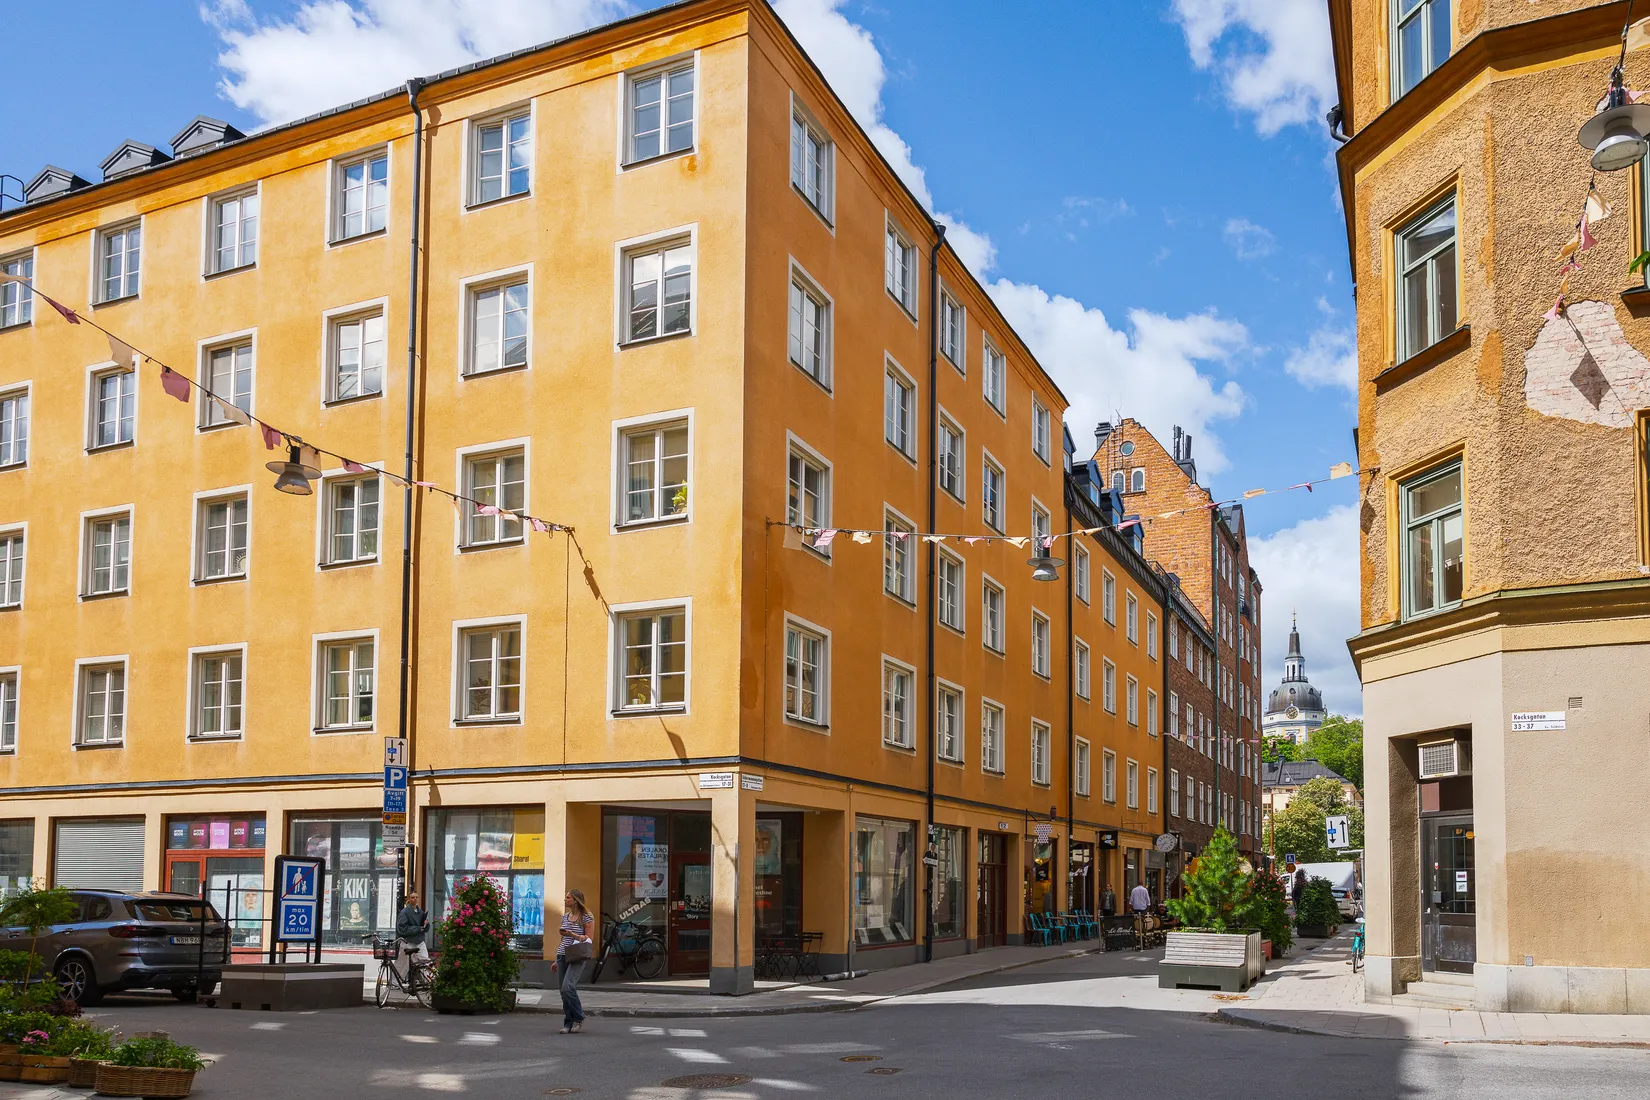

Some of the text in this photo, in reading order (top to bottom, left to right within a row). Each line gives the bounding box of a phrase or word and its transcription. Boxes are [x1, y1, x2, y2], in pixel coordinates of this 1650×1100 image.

[390, 768, 403, 787] P
[343, 878, 368, 899] KIKI
[619, 896, 652, 920] ULTRAS
[288, 914, 308, 926] 20
